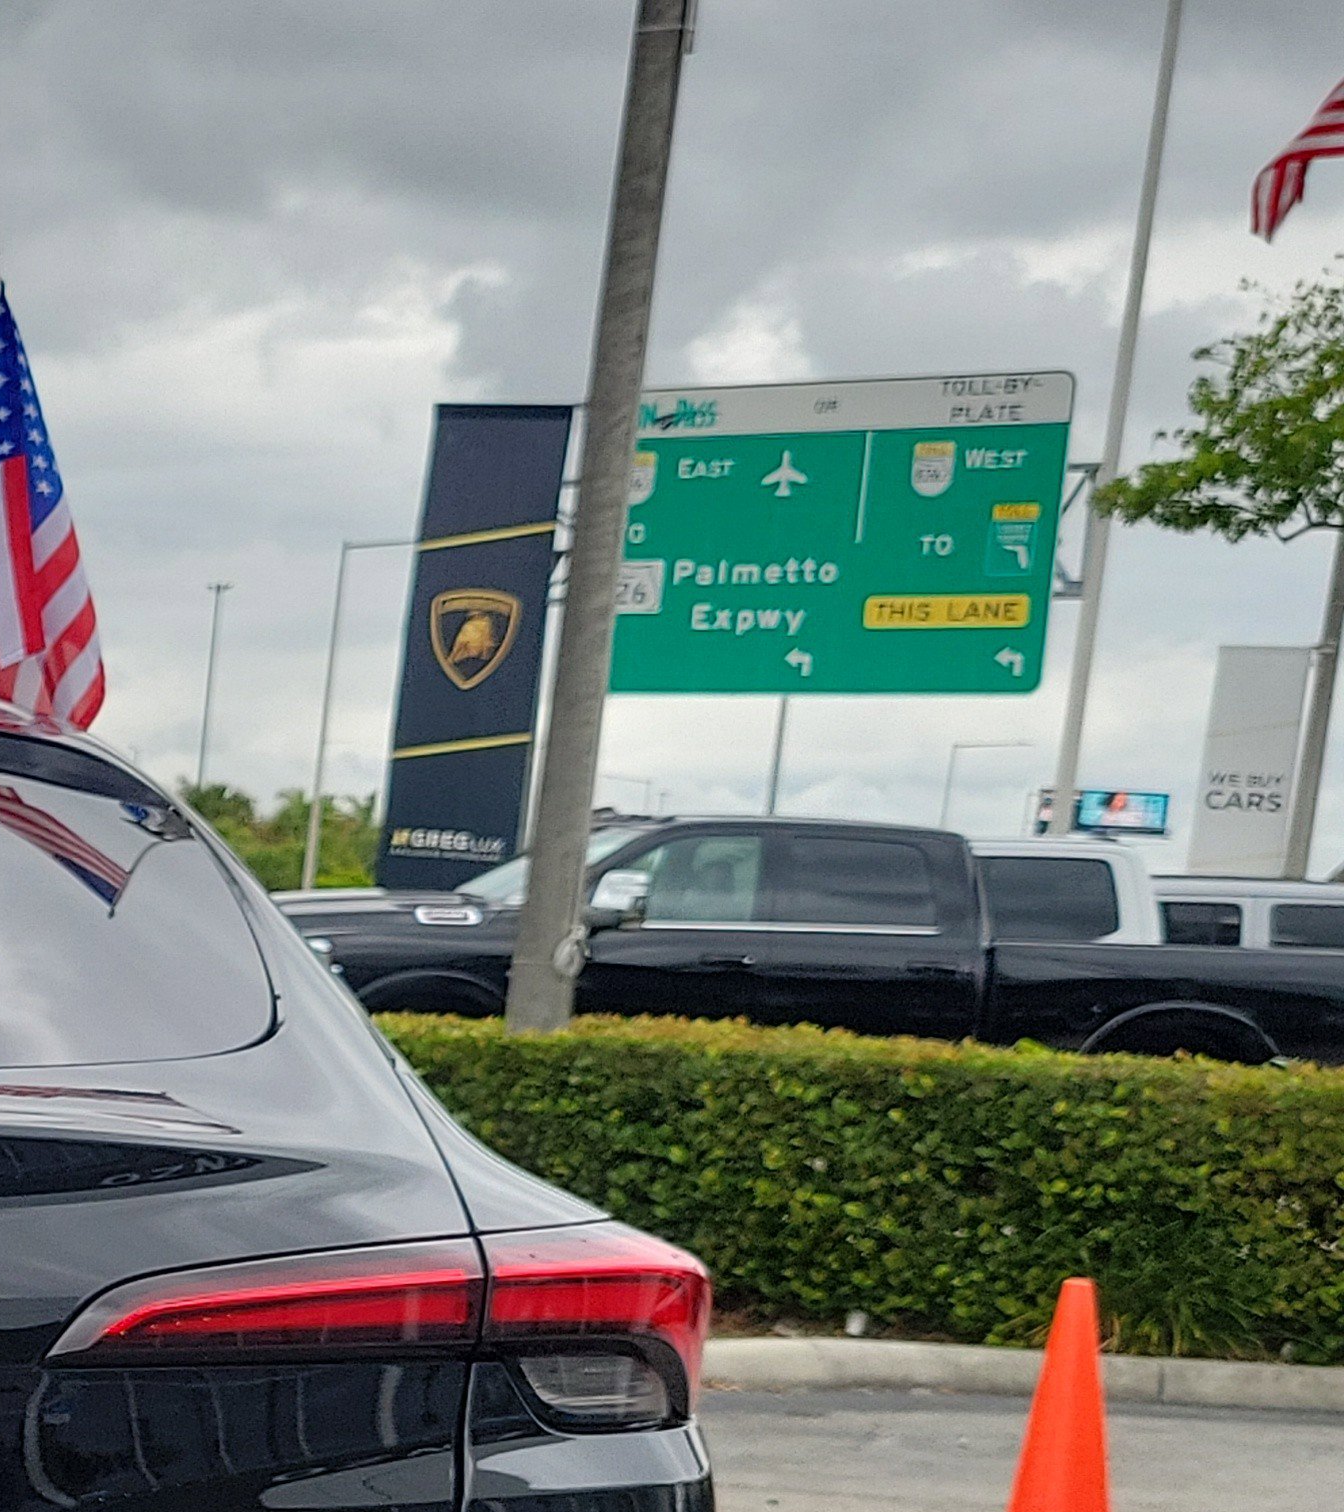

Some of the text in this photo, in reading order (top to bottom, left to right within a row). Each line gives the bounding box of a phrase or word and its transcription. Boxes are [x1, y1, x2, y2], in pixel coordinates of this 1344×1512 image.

[949, 404, 1025, 423] PLATE
[678, 456, 735, 479] EAST
[964, 447, 1028, 470] WEST
[628, 522, 646, 544] O
[919, 533, 955, 556] TO
[672, 556, 840, 586] Palmetto
[615, 582, 646, 604] 26
[691, 602, 806, 636] Expwy
[875, 602, 1020, 622] THIS LANE
[1209, 773, 1241, 788] WE
[1205, 790, 1282, 812] CARS
